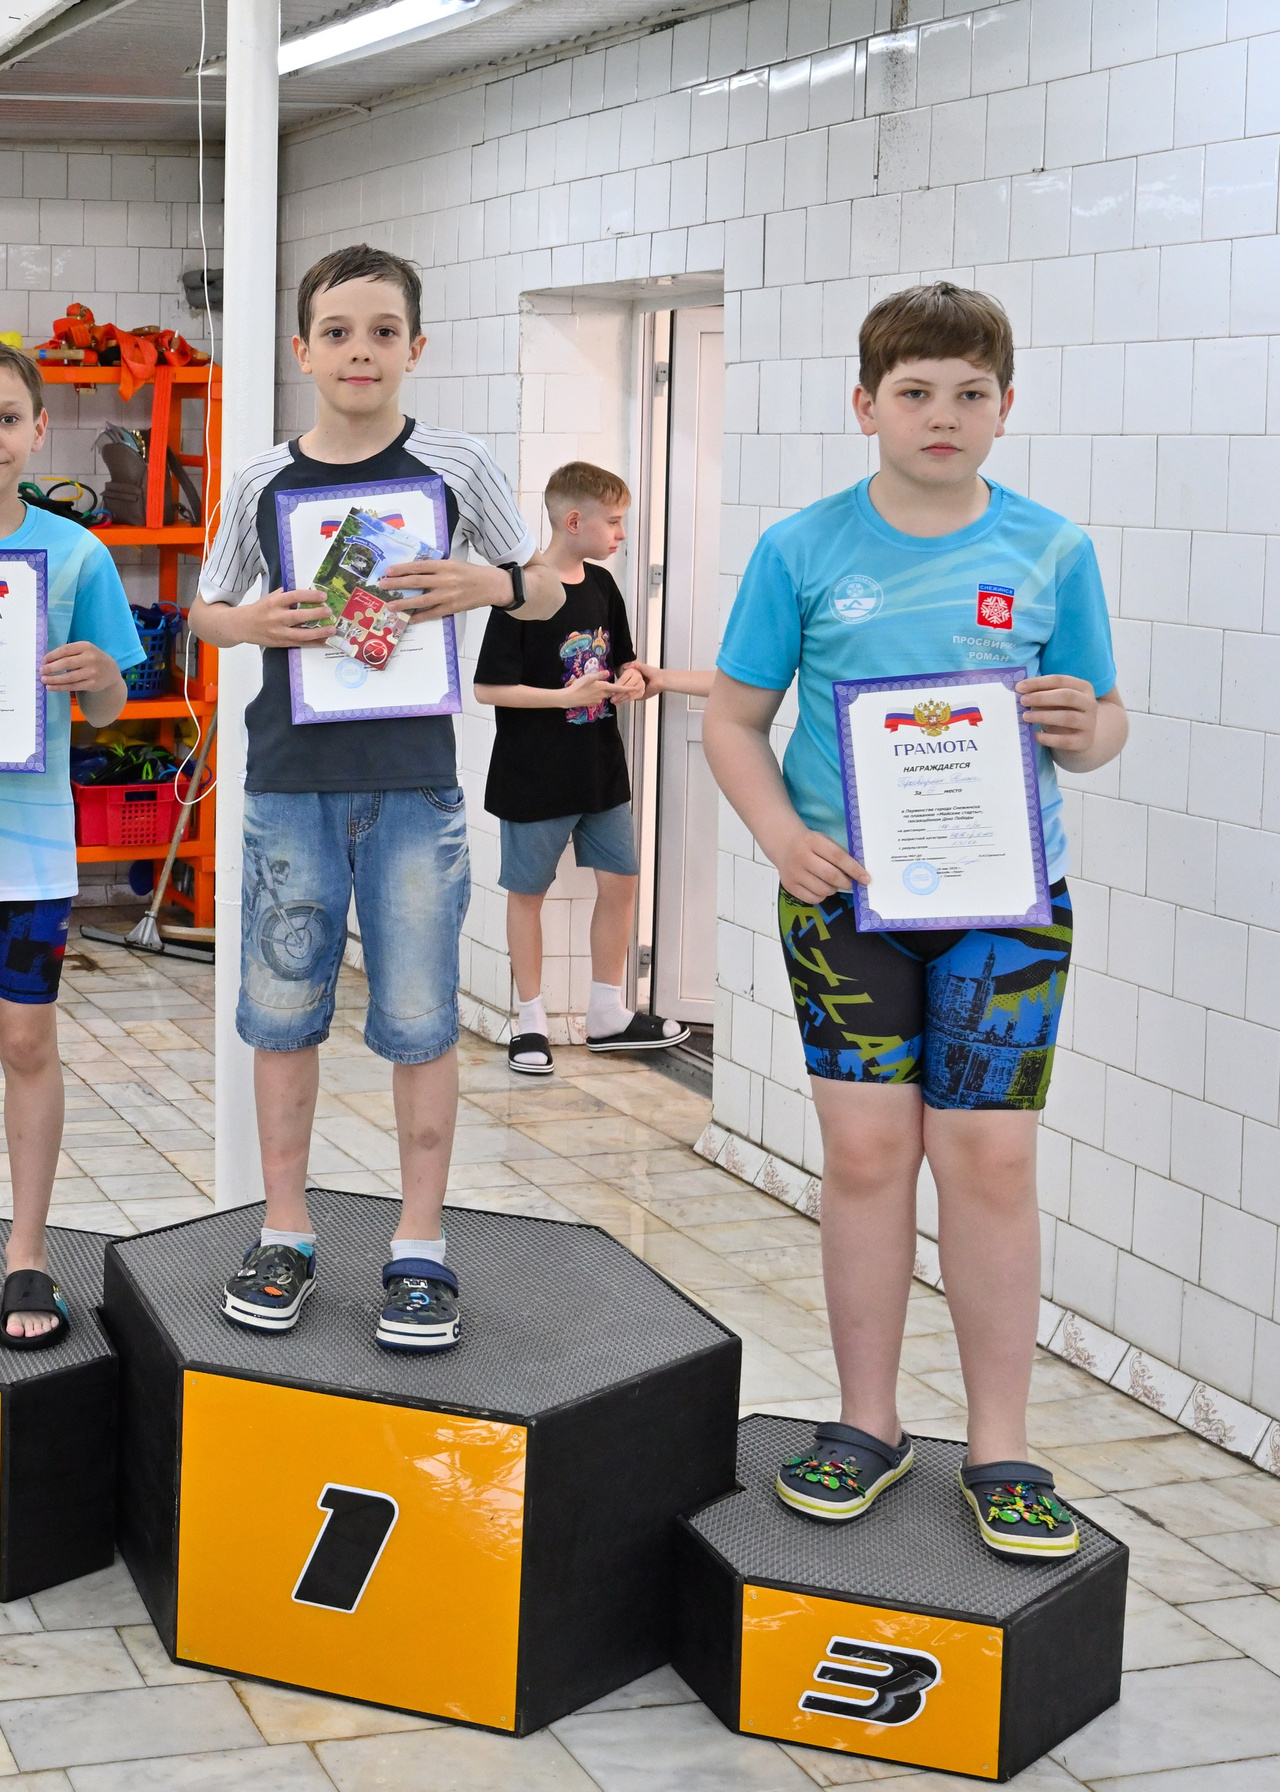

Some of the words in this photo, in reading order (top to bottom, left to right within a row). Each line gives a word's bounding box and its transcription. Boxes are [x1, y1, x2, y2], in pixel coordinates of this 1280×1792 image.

[979, 584, 1014, 595] СНЕЖИНСК
[969, 651, 1010, 662] РОМАН
[894, 739, 978, 756] ГРАМОТА
[903, 762, 971, 773] НАГРАЖДАЕТСЯ
[291, 1482, 399, 1614] 1
[798, 1635, 942, 1727] 3
